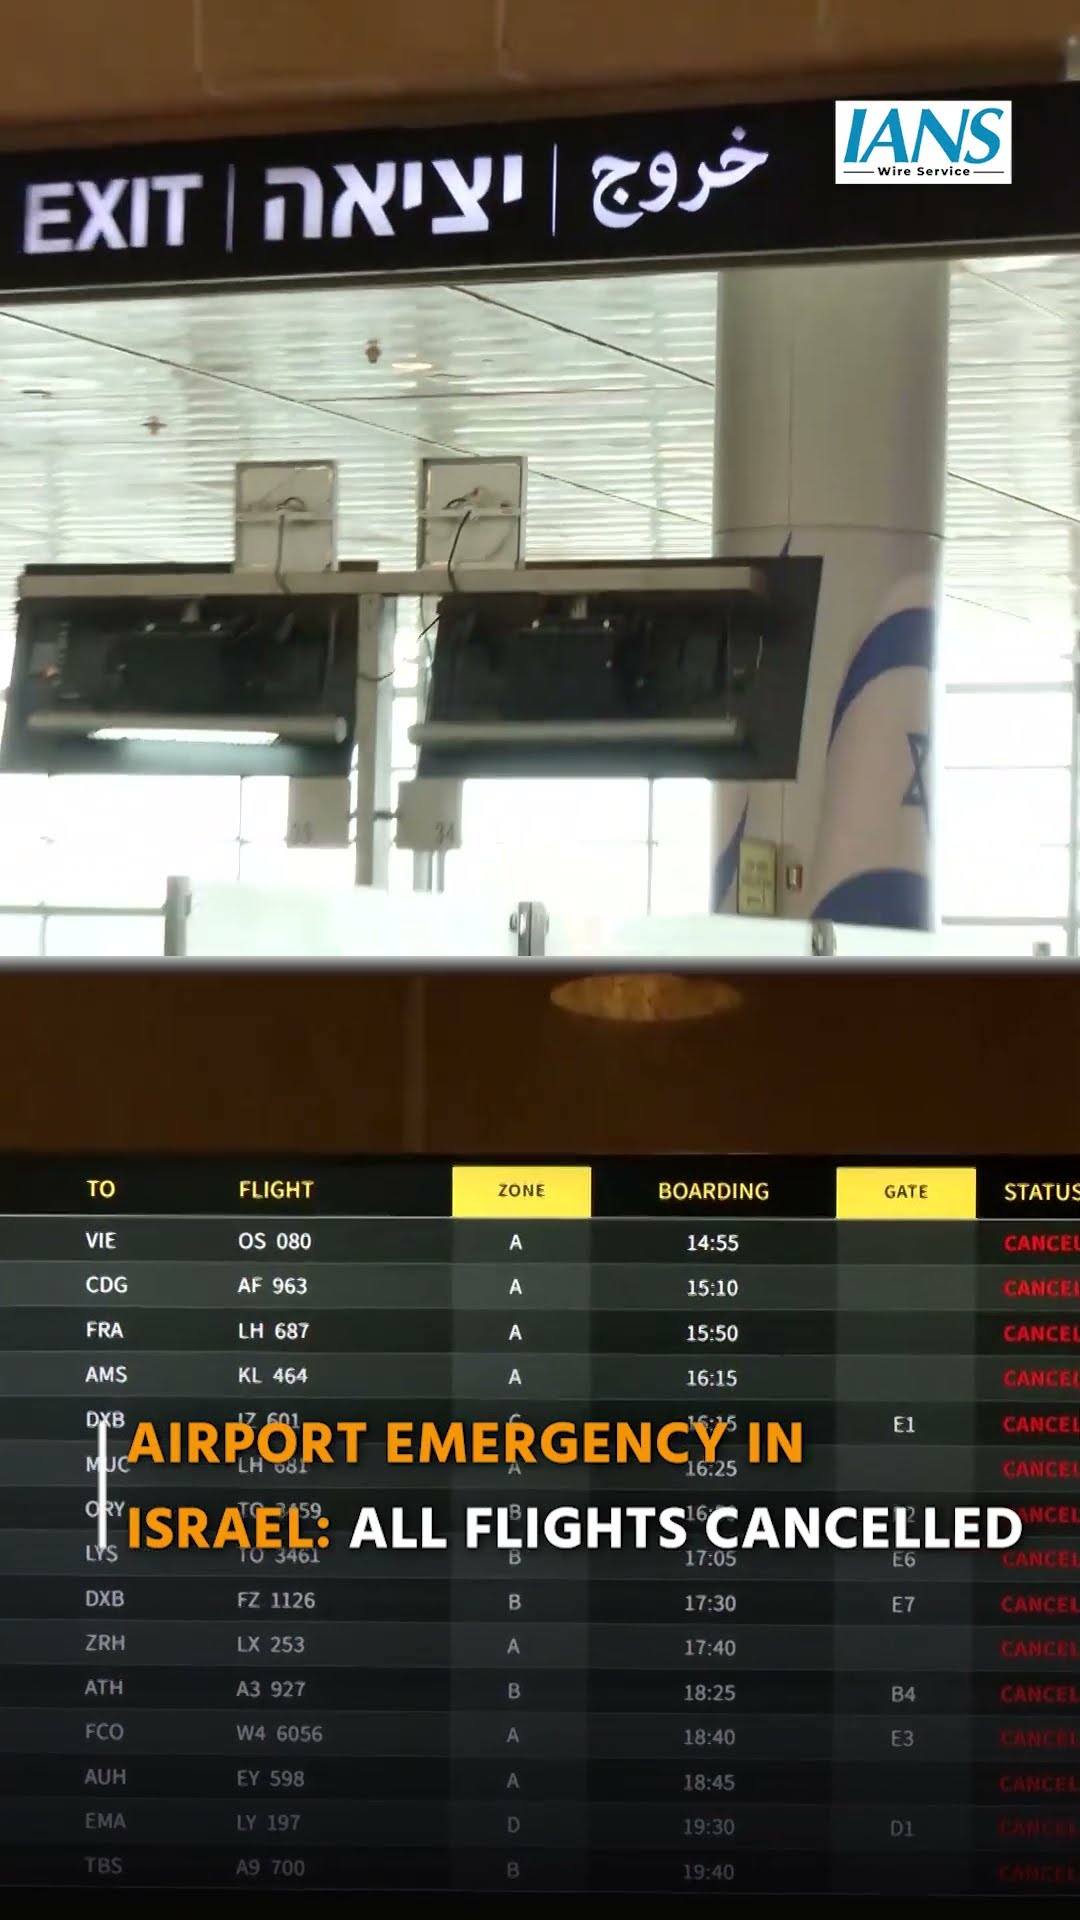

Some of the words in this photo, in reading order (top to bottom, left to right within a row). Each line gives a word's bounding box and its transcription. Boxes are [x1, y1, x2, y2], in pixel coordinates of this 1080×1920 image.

[591, 125, 769, 229] خروج
[264, 154, 523, 241] יציאה
[23, 174, 204, 254] EXIT
[87, 1180, 115, 1197] TO
[239, 1180, 314, 1199] FLIGHT
[498, 1183, 545, 1197] ZONE
[659, 1182, 770, 1201] BOARDING
[884, 1184, 928, 1199] GATE
[1004, 1183, 1080, 1201] STATUS
[86, 1231, 116, 1249] VIE
[238, 1233, 266, 1250] OS
[276, 1233, 311, 1250] 080
[509, 1234, 522, 1251] A
[686, 1235, 739, 1252] 14:55
[86, 1276, 127, 1294] CDG
[238, 1277, 262, 1294] AF
[272, 1278, 307, 1295] 963
[509, 1279, 522, 1295] A
[687, 1280, 738, 1297] 15:10
[86, 1321, 124, 1339] FRA
[239, 1323, 263, 1339] LH
[274, 1323, 309, 1339] 687
[509, 1324, 522, 1341] A
[686, 1325, 738, 1342] 15:50
[86, 1366, 127, 1383] AMS
[239, 1367, 262, 1384] KL
[273, 1368, 308, 1384] 464
[509, 1369, 522, 1385] A
[686, 1370, 737, 1387] 16:15
[86, 1412, 124, 1428] DXB
[894, 1417, 915, 1433] E1
[239, 1457, 263, 1474] LH
[686, 1460, 737, 1477] 16:25
[275, 1503, 322, 1520] 359
[510, 1504, 522, 1520] B
[86, 1545, 118, 1563] LYS
[274, 1548, 320, 1564] 3461
[509, 1549, 521, 1565] B
[685, 1551, 737, 1567] 17:05
[892, 1552, 916, 1568] E6
[86, 1590, 124, 1607] DXB
[238, 1592, 259, 1608] FZ
[271, 1592, 316, 1609] 1126
[509, 1594, 521, 1610] B
[685, 1596, 737, 1612] 17:30
[892, 1597, 915, 1613] E7
[85, 1635, 125, 1651] ZRH
[238, 1636, 260, 1653] LX
[270, 1636, 305, 1653] 253
[507, 1639, 520, 1655] A
[685, 1641, 736, 1657] 17:40
[85, 1679, 123, 1696] ATH
[237, 1681, 260, 1697] A3
[270, 1681, 305, 1698] 927
[509, 1683, 521, 1699] B
[684, 1685, 736, 1701] 18:25
[891, 1687, 916, 1702] B4
[86, 1723, 124, 1740] FCO
[237, 1725, 266, 1742] W4
[276, 1725, 323, 1742] 6056
[507, 1728, 520, 1743] A
[684, 1730, 735, 1746] 18:40
[891, 1731, 914, 1747] E3
[84, 1769, 127, 1785] AUH
[237, 1771, 259, 1786] EY
[270, 1771, 304, 1787] 598
[507, 1773, 519, 1789] A
[684, 1775, 735, 1791] 18:45
[86, 1813, 126, 1829] EMA
[237, 1815, 257, 1831] LY
[268, 1815, 301, 1831] 197
[508, 1817, 520, 1833] D
[683, 1819, 735, 1835] 19:30
[891, 1821, 915, 1836] D1
[85, 1858, 123, 1874] TBS
[236, 1860, 260, 1875] A9
[271, 1860, 305, 1877] 700
[508, 1862, 519, 1878] B
[683, 1864, 734, 1880] 19:40
